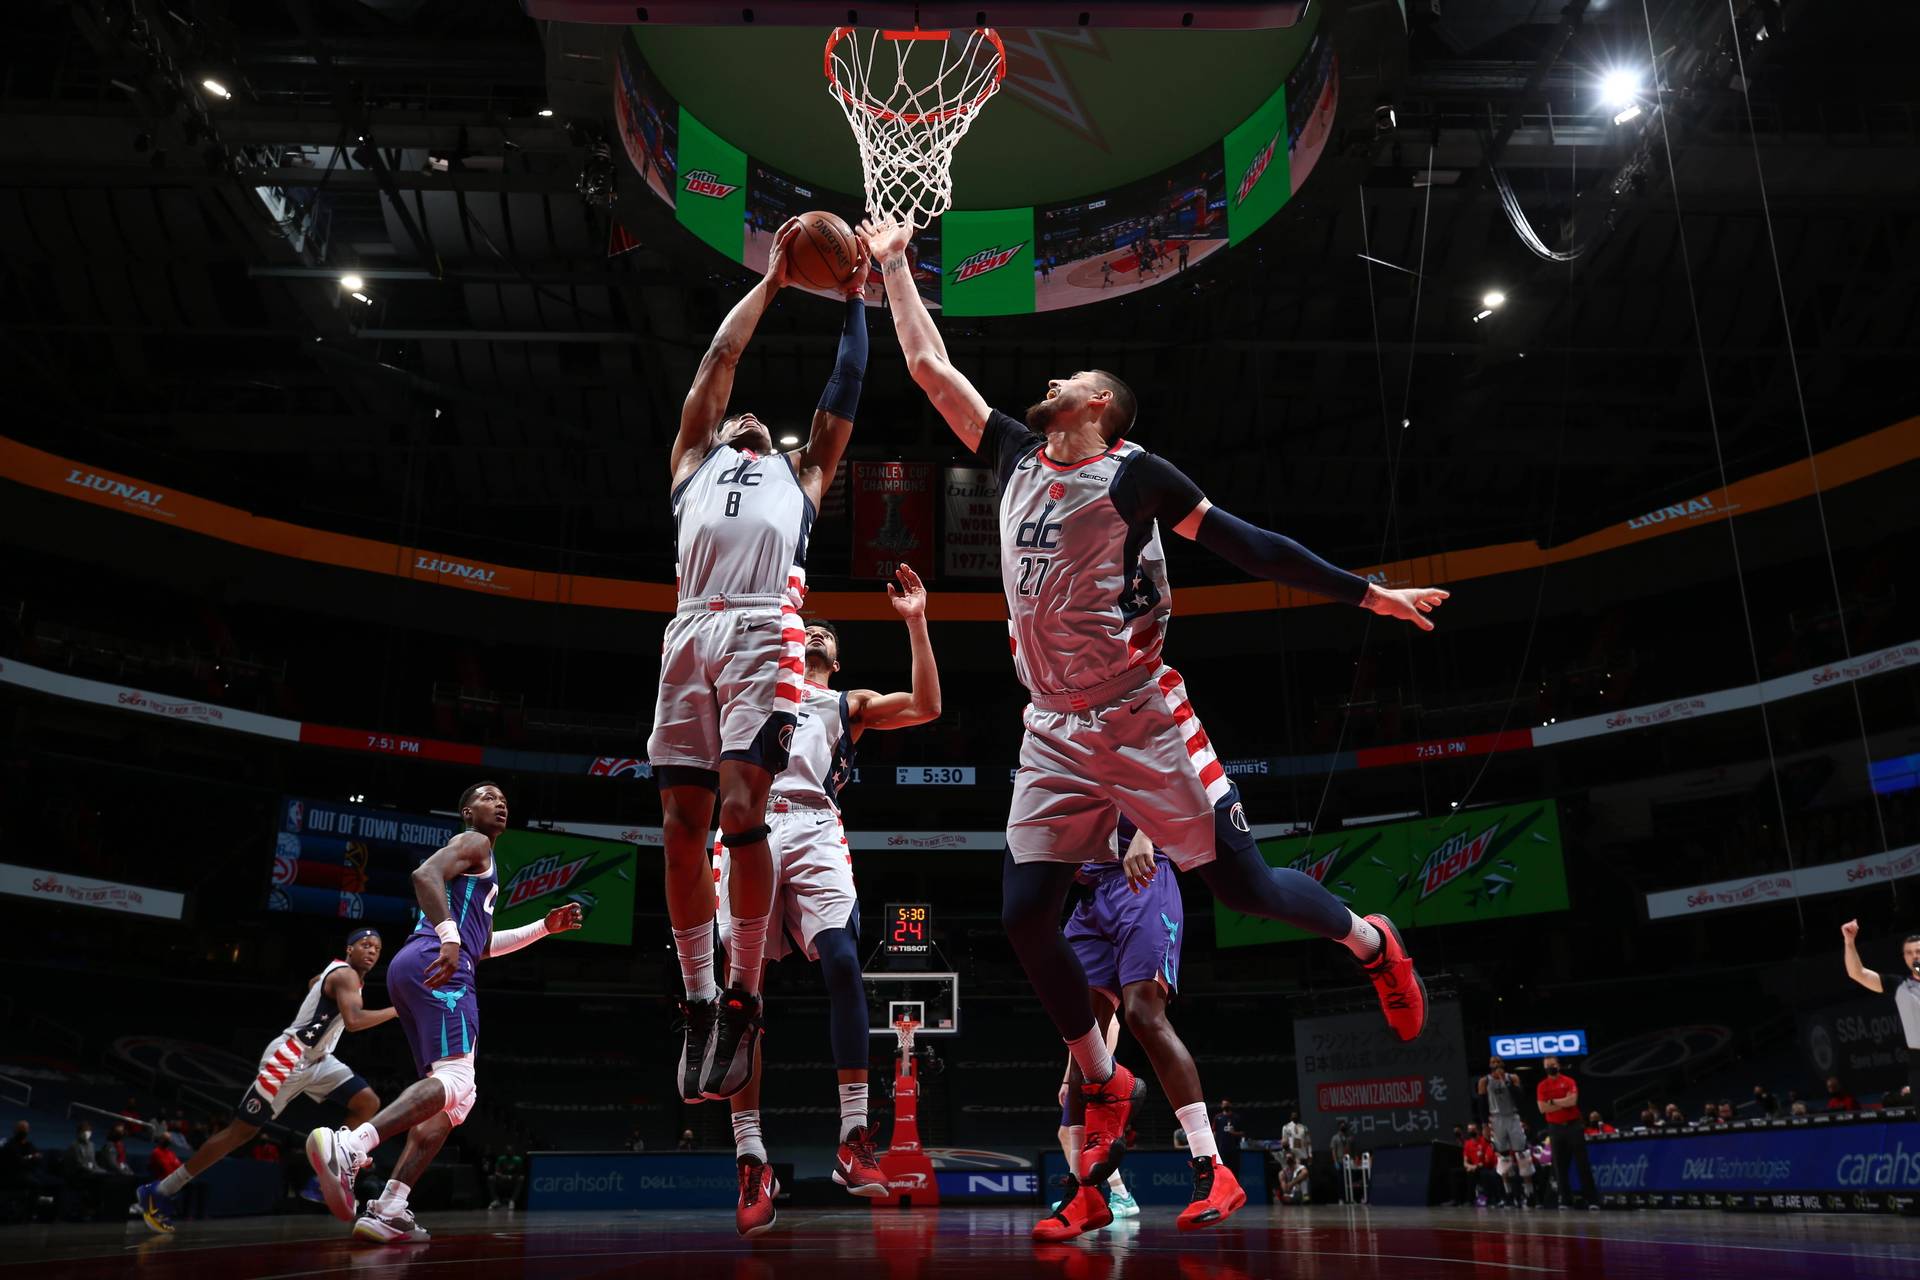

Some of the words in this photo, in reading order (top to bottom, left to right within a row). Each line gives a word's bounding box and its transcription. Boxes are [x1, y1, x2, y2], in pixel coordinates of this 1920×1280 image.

[858, 466, 905, 478] STANLEY
[911, 467, 929, 478] CUP
[1079, 472, 1108, 482] GEICO
[864, 480, 928, 492] CHAMPIONS
[947, 485, 999, 497] bulle
[724, 491, 742, 517] 8
[969, 503, 992, 516] NBA
[946, 532, 1001, 545] CHAMPIO
[952, 553, 1001, 569] 1977-7
[1019, 557, 1049, 596] 27
[367, 736, 395, 750] 7:51
[400, 740, 420, 753] PM
[1416, 743, 1443, 757] 7:51
[1447, 741, 1467, 753] PM
[923, 768, 963, 783] 5:30
[1224, 762, 1268, 775] ORNETS
[901, 775, 907, 783] 2
[309, 808, 336, 832] OUT
[338, 814, 356, 834] OF
[358, 816, 399, 841] TOWN
[401, 822, 452, 848] SCORES
[899, 908, 925, 920] 5:30
[893, 920, 923, 942] 24
[1495, 1033, 1581, 1057] GEICO
[1320, 1080, 1422, 1110] @WASHWIZARDSJP
[1429, 1075, 1448, 1101] を
[1682, 1157, 1715, 1180] DELL
[1716, 1156, 1791, 1185] Technologies
[1837, 1140, 1920, 1187] carahs
[533, 1170, 625, 1192] carahsoft
[640, 1175, 676, 1189] DELL
[678, 1175, 739, 1192] Technolog
[968, 1175, 1039, 1193] NE
[1771, 1195, 1785, 1208] WE
[1785, 1195, 1801, 1208] ARE
[1802, 1195, 1822, 1209] WGL
